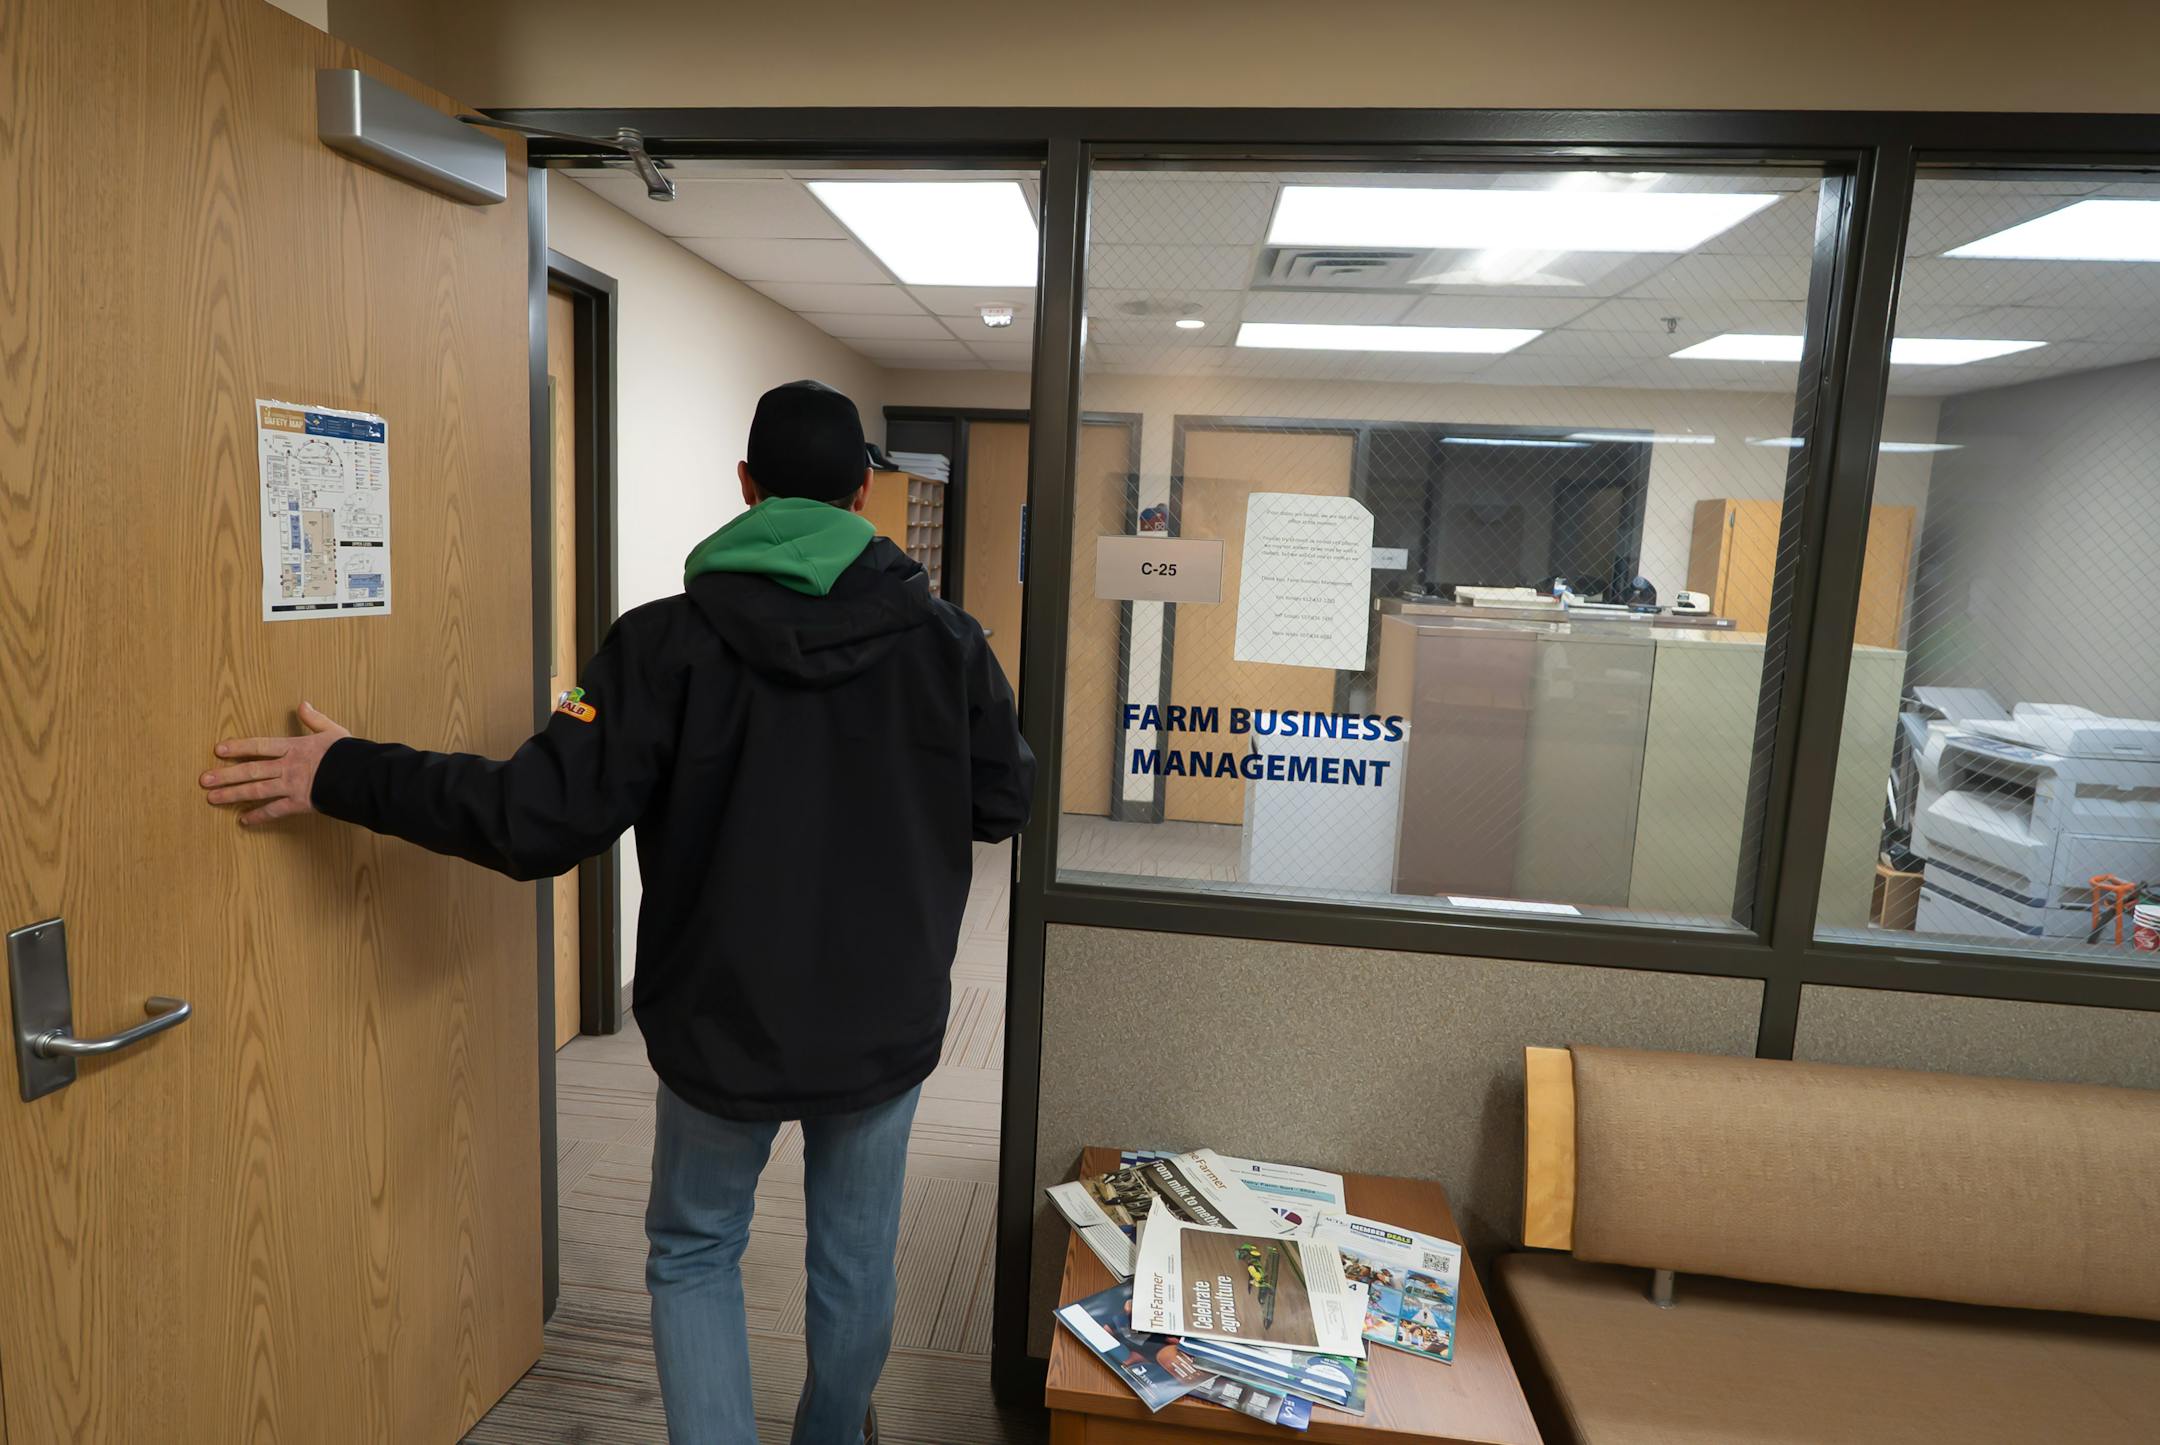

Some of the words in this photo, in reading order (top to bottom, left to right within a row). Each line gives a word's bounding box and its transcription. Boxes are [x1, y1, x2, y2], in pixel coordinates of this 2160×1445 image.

[264, 416, 288, 427] SAFETY
[288, 419, 304, 429] MAP
[1141, 562, 1177, 576] C-25
[1123, 704, 1219, 733] FARM
[1230, 708, 1404, 742] BUSINESS
[1131, 749, 1391, 787] MANAGEMENT
[1152, 1160, 1174, 1181] From
[1168, 1178, 1191, 1200] milk
[1184, 1194, 1196, 1208] to
[1352, 1224, 1386, 1238] MEMBER
[1386, 1232, 1412, 1244] DEALS
[1192, 1280, 1213, 1329] Celebrate
[1214, 1274, 1241, 1333] agriculture
